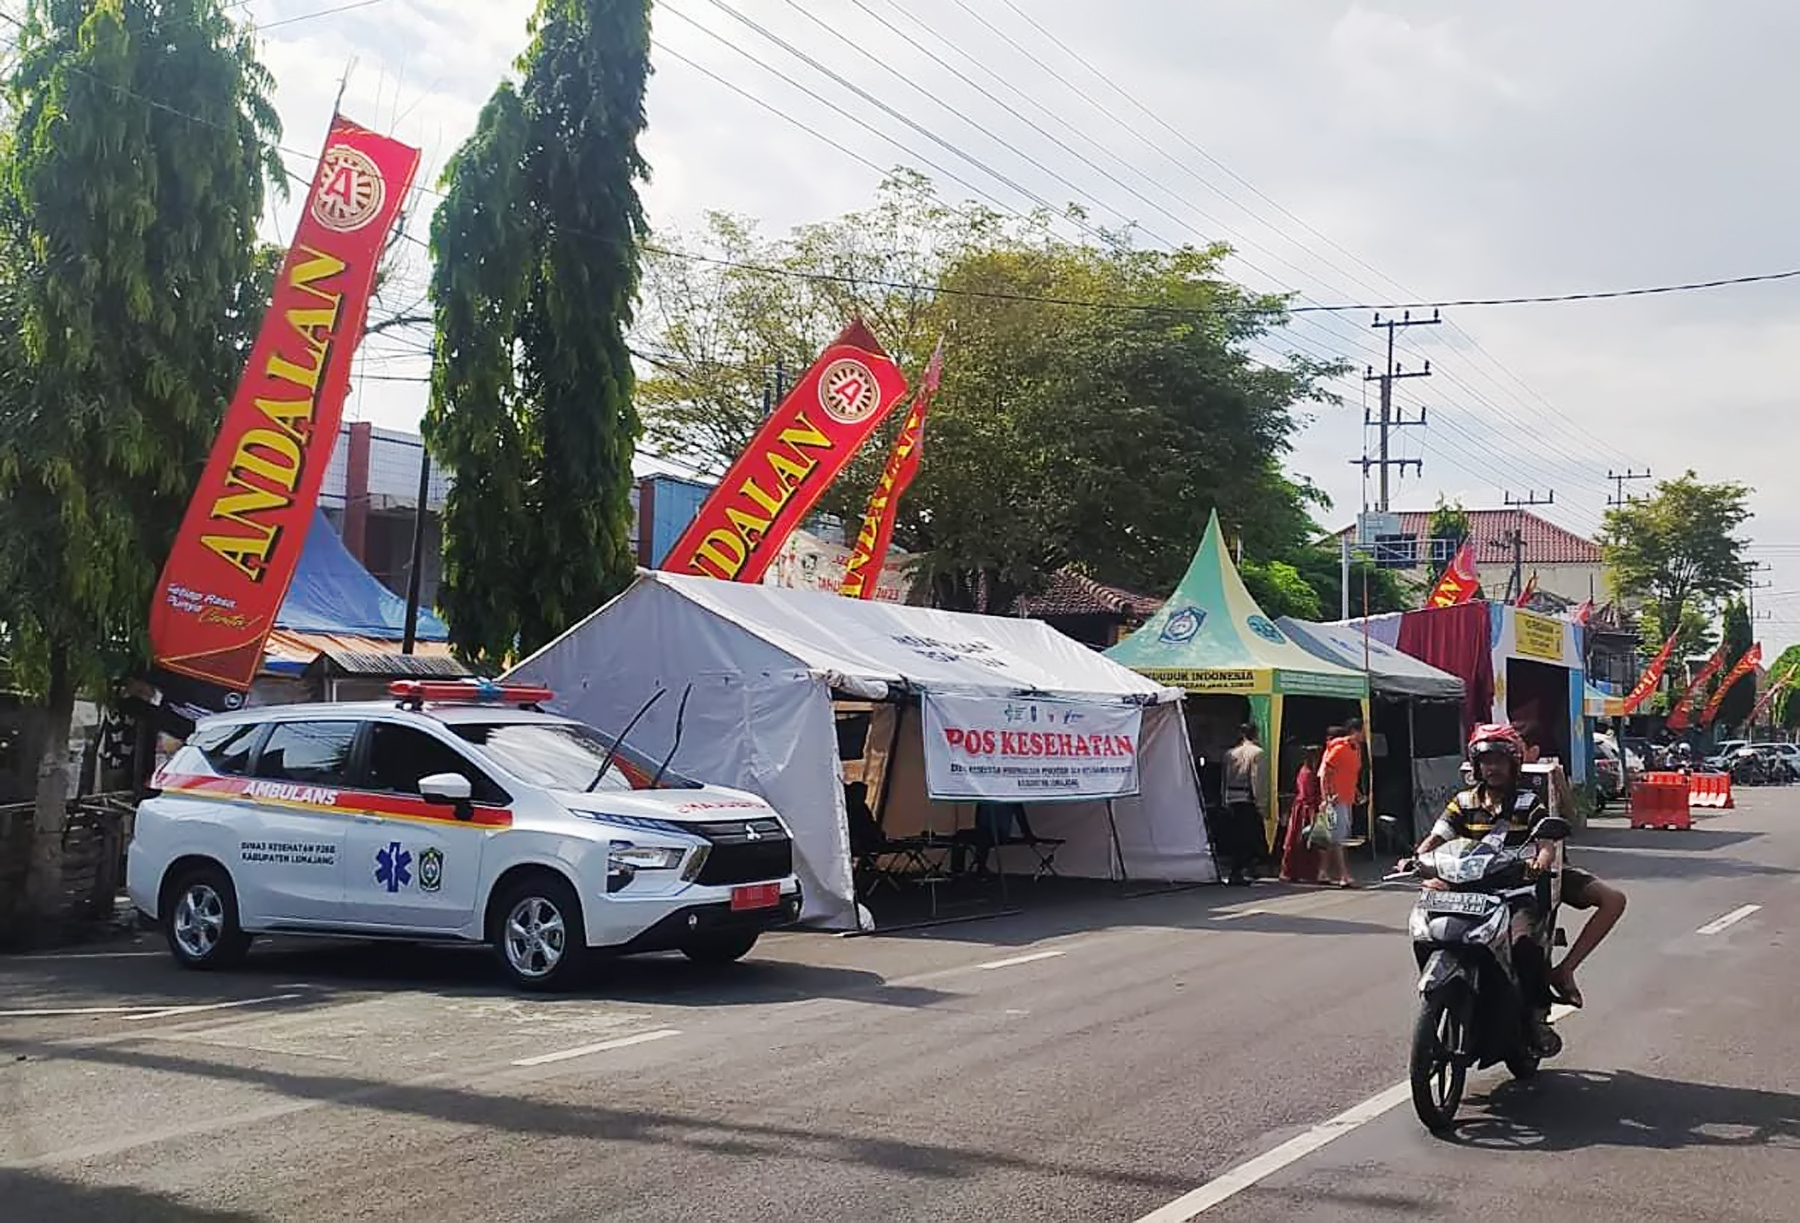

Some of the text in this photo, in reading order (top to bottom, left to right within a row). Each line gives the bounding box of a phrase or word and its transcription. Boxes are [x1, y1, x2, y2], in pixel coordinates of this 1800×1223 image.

[200, 243, 347, 582] ANDALAN
[1191, 670, 1255, 682] INDONESIA
[943, 727, 1136, 757] POS KESEHATAN
[242, 780, 339, 806] AMBULANS
